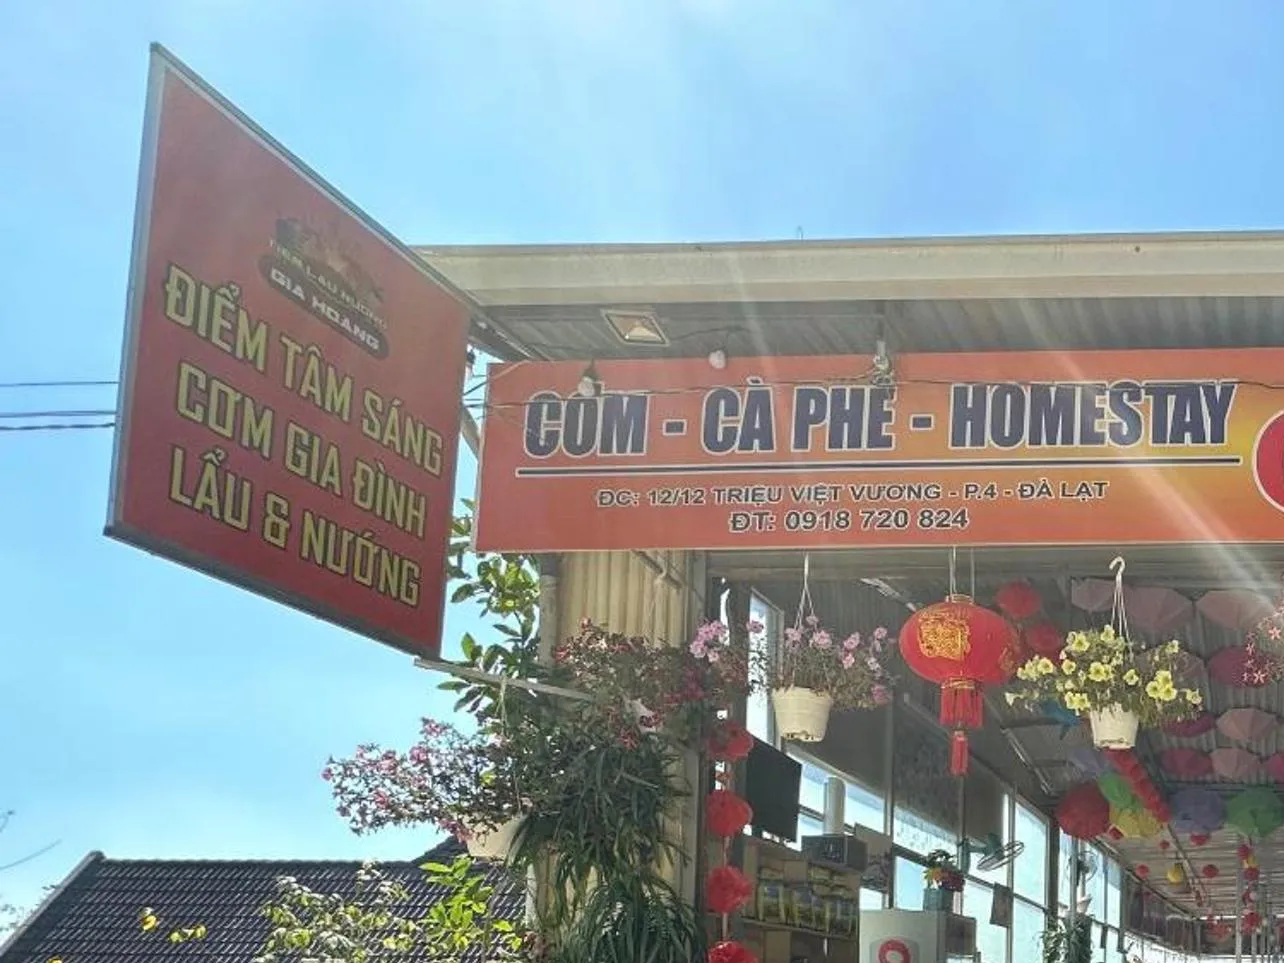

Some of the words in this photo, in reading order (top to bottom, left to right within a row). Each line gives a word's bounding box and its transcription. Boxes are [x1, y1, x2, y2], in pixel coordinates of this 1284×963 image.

[165, 261, 266, 375] ĐIỂM
[280, 335, 352, 422] TÂM
[360, 383, 441, 478] SÁNG
[662, 419, 687, 436] -
[700, 376, 777, 455] CÀ
[910, 412, 935, 432] -
[948, 379, 1239, 450] HOMESTAY
[176, 360, 271, 459] CƠM
[285, 421, 341, 497] GIA
[352, 459, 425, 539] ĐÌNH
[597, 488, 640, 507] ĐC:
[648, 488, 705, 506] 12/12
[713, 486, 783, 508] TRIỆU
[790, 484, 842, 507] VIỆT
[849, 483, 941, 500] VƯƠNG
[964, 483, 997, 499] P.4
[1017, 479, 1053, 498] ĐÀ
[1060, 481, 1108, 502] LẠT
[170, 444, 248, 532] LẨU
[262, 493, 289, 549] &
[300, 509, 420, 609] NƯỚNG
[729, 510, 775, 531] ĐT:
[785, 510, 852, 530] 0918
[860, 509, 909, 529] 720
[918, 508, 968, 529] 824
